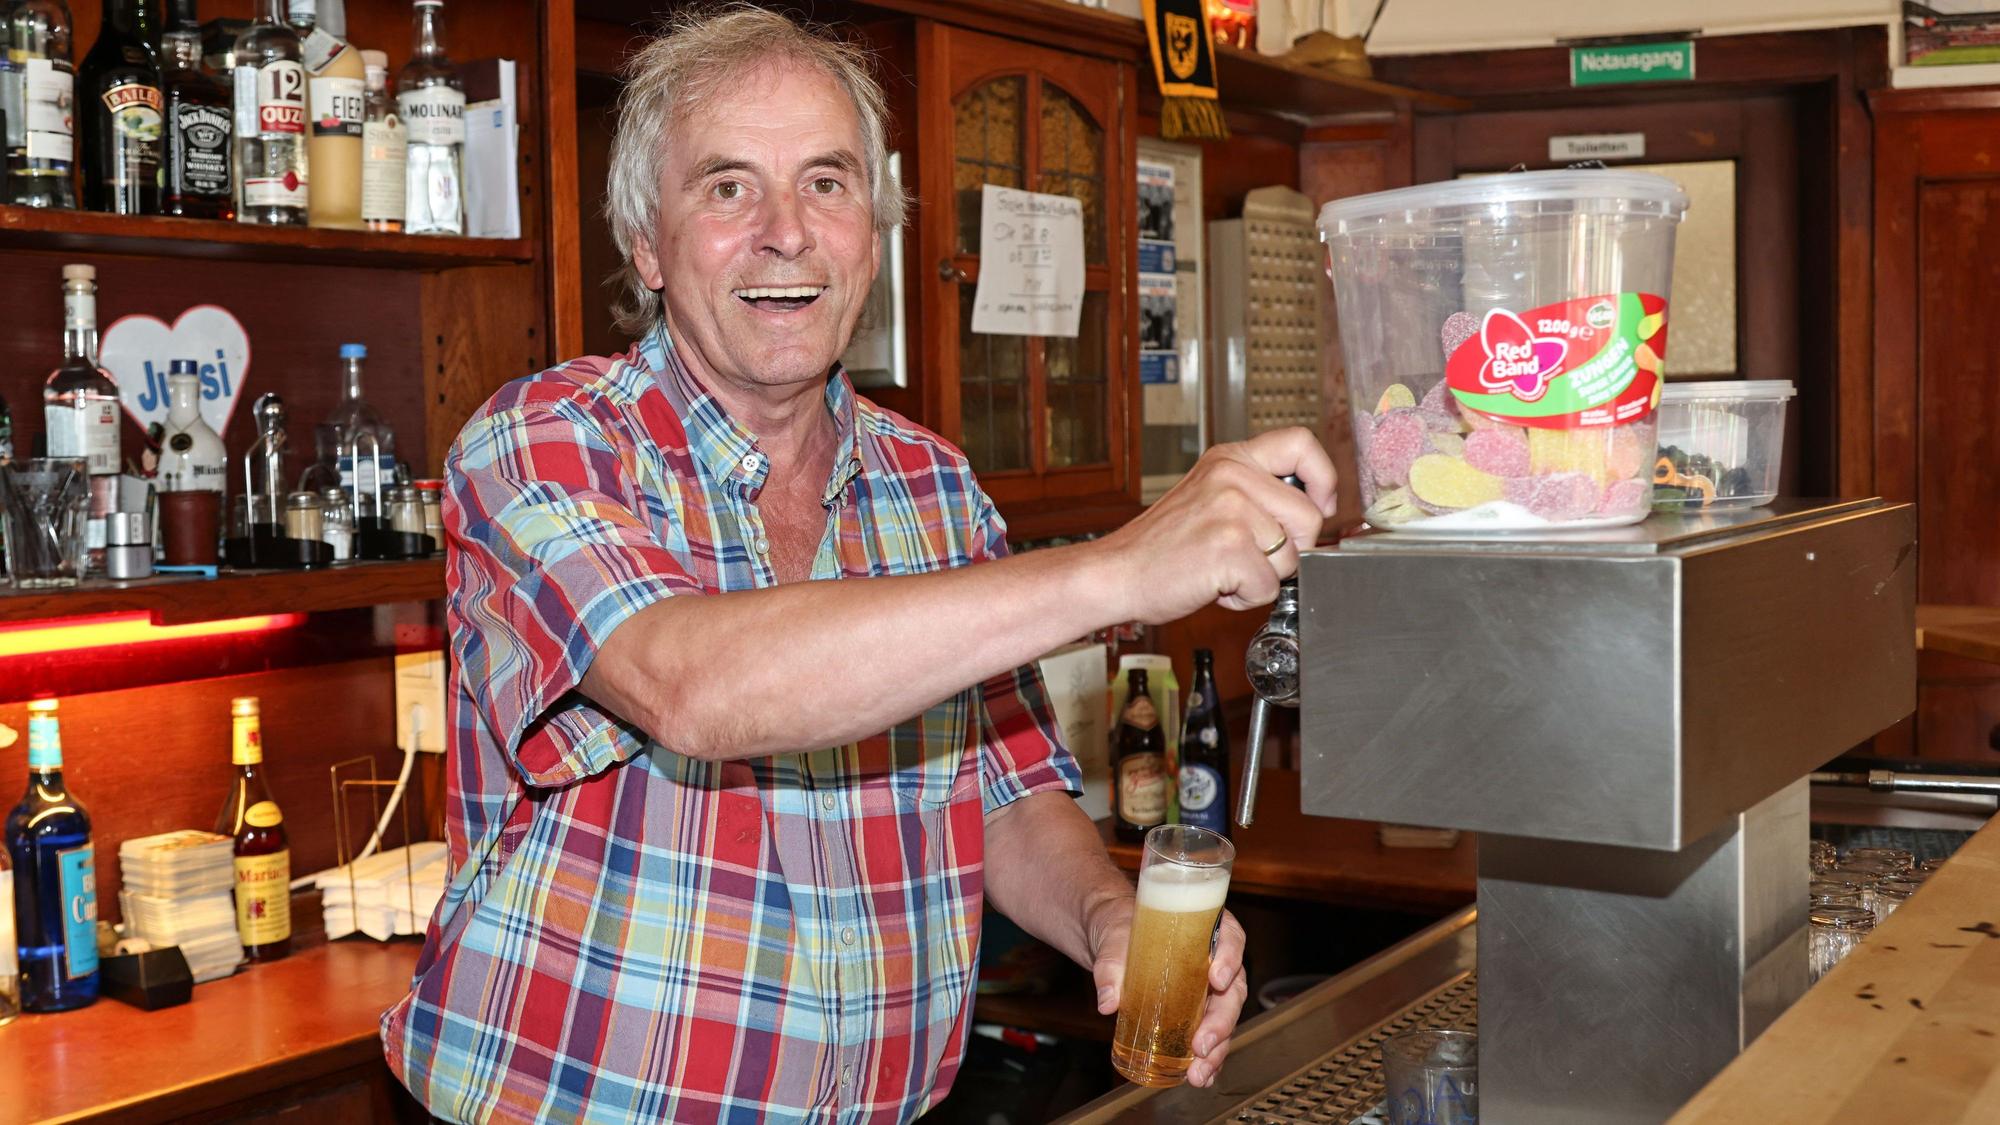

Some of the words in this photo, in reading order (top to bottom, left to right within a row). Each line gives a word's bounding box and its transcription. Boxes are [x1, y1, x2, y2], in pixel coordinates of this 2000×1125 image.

[1580, 50, 1684, 73] Notausgang
[272, 69, 303, 101] 12
[262, 106, 304, 124] OUZ
[1495, 339, 1532, 363] Red
[1492, 355, 1539, 378] Band
